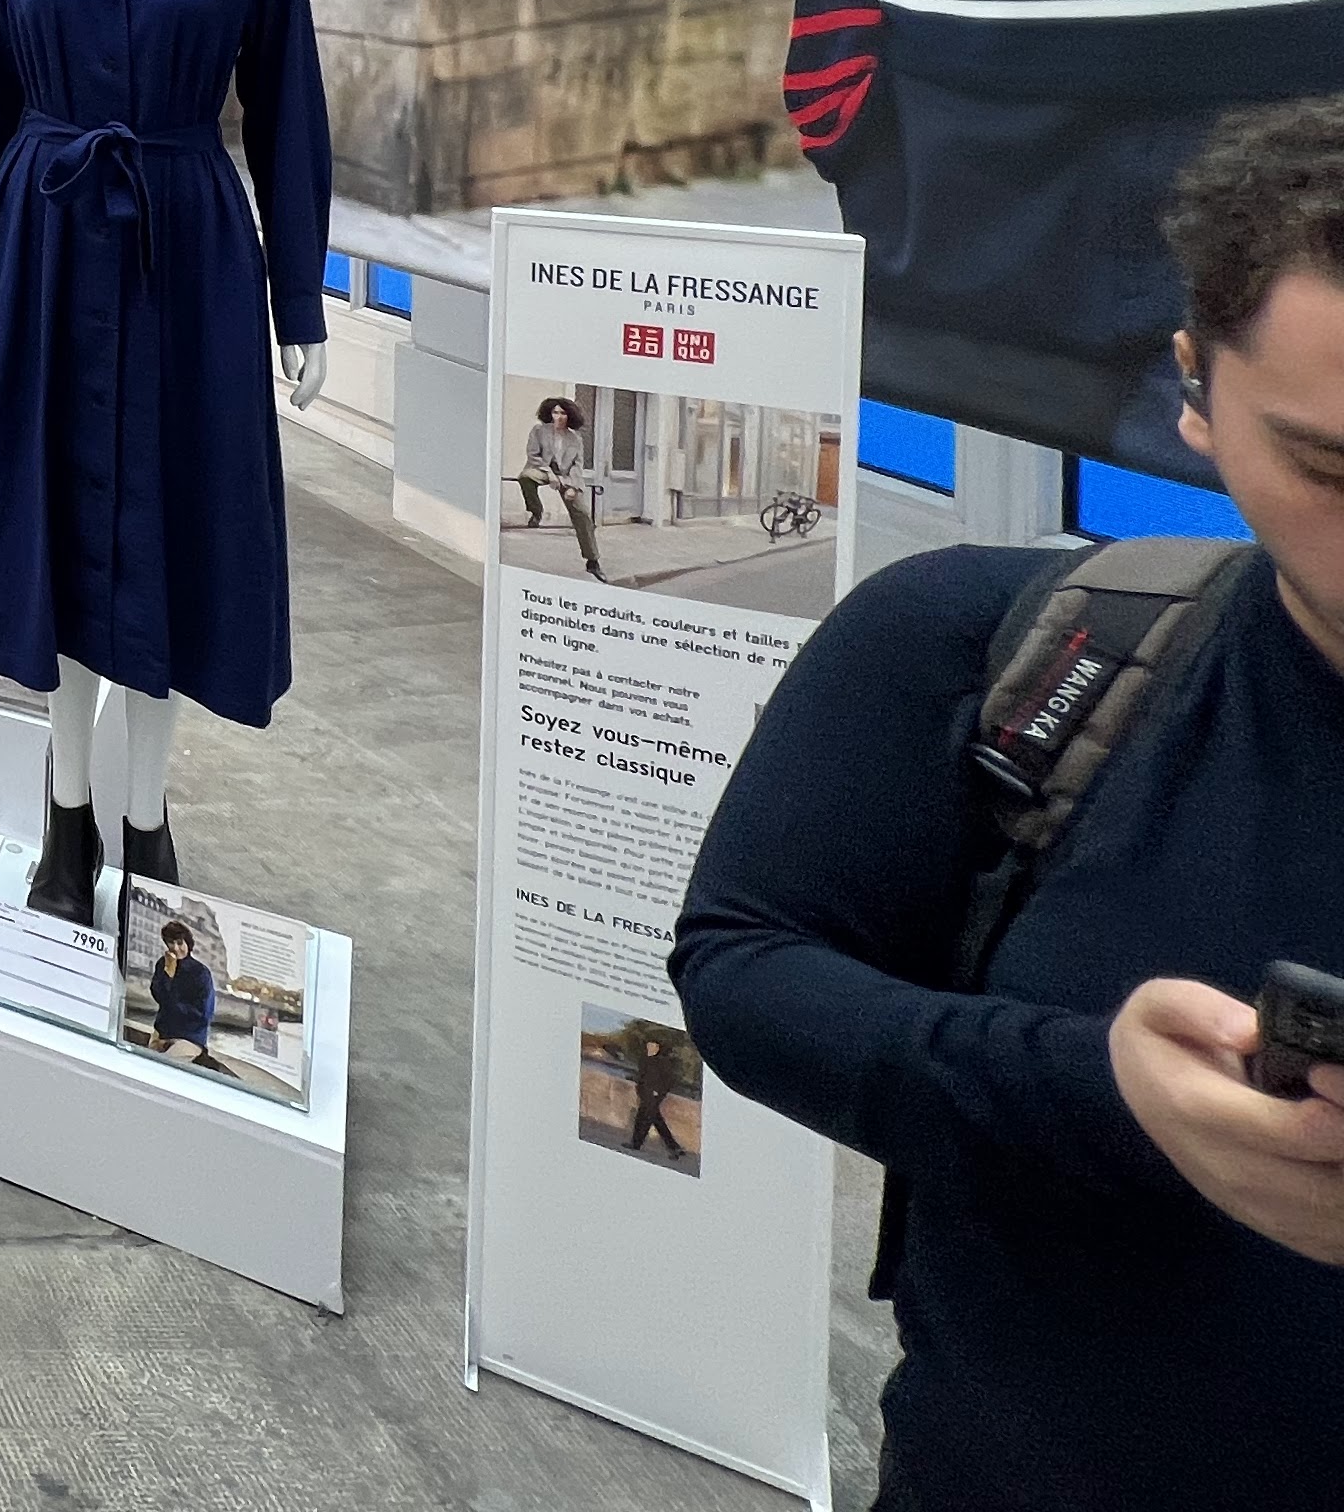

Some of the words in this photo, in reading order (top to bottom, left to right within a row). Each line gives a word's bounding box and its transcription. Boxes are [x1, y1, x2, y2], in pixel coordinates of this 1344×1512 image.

[530, 262, 584, 287] INES
[592, 268, 623, 292] DE
[630, 271, 660, 296] LA
[667, 274, 820, 311] FRESSANGE
[643, 299, 696, 317] PARIS
[520, 627, 534, 639] et
[540, 632, 557, 644] en
[563, 634, 600, 654] ligne.
[521, 588, 553, 606] Tous
[558, 596, 578, 612] les
[652, 617, 716, 637] couleurs
[722, 628, 737, 640] et
[745, 630, 790, 650] tailles
[521, 608, 596, 633] disponibles
[601, 625, 635, 641] dans
[640, 633, 668, 647] une
[674, 638, 741, 661] sélection
[746, 651, 766, 665] de
[520, 704, 582, 735] Soyez
[1023, 658, 1103, 740] WANGKA
[520, 733, 586, 762] restez
[596, 751, 696, 787] classique
[516, 887, 550, 908] INES
[556, 900, 577, 917] DE
[583, 908, 605, 925] LA
[612, 916, 674, 944] FRESSA
